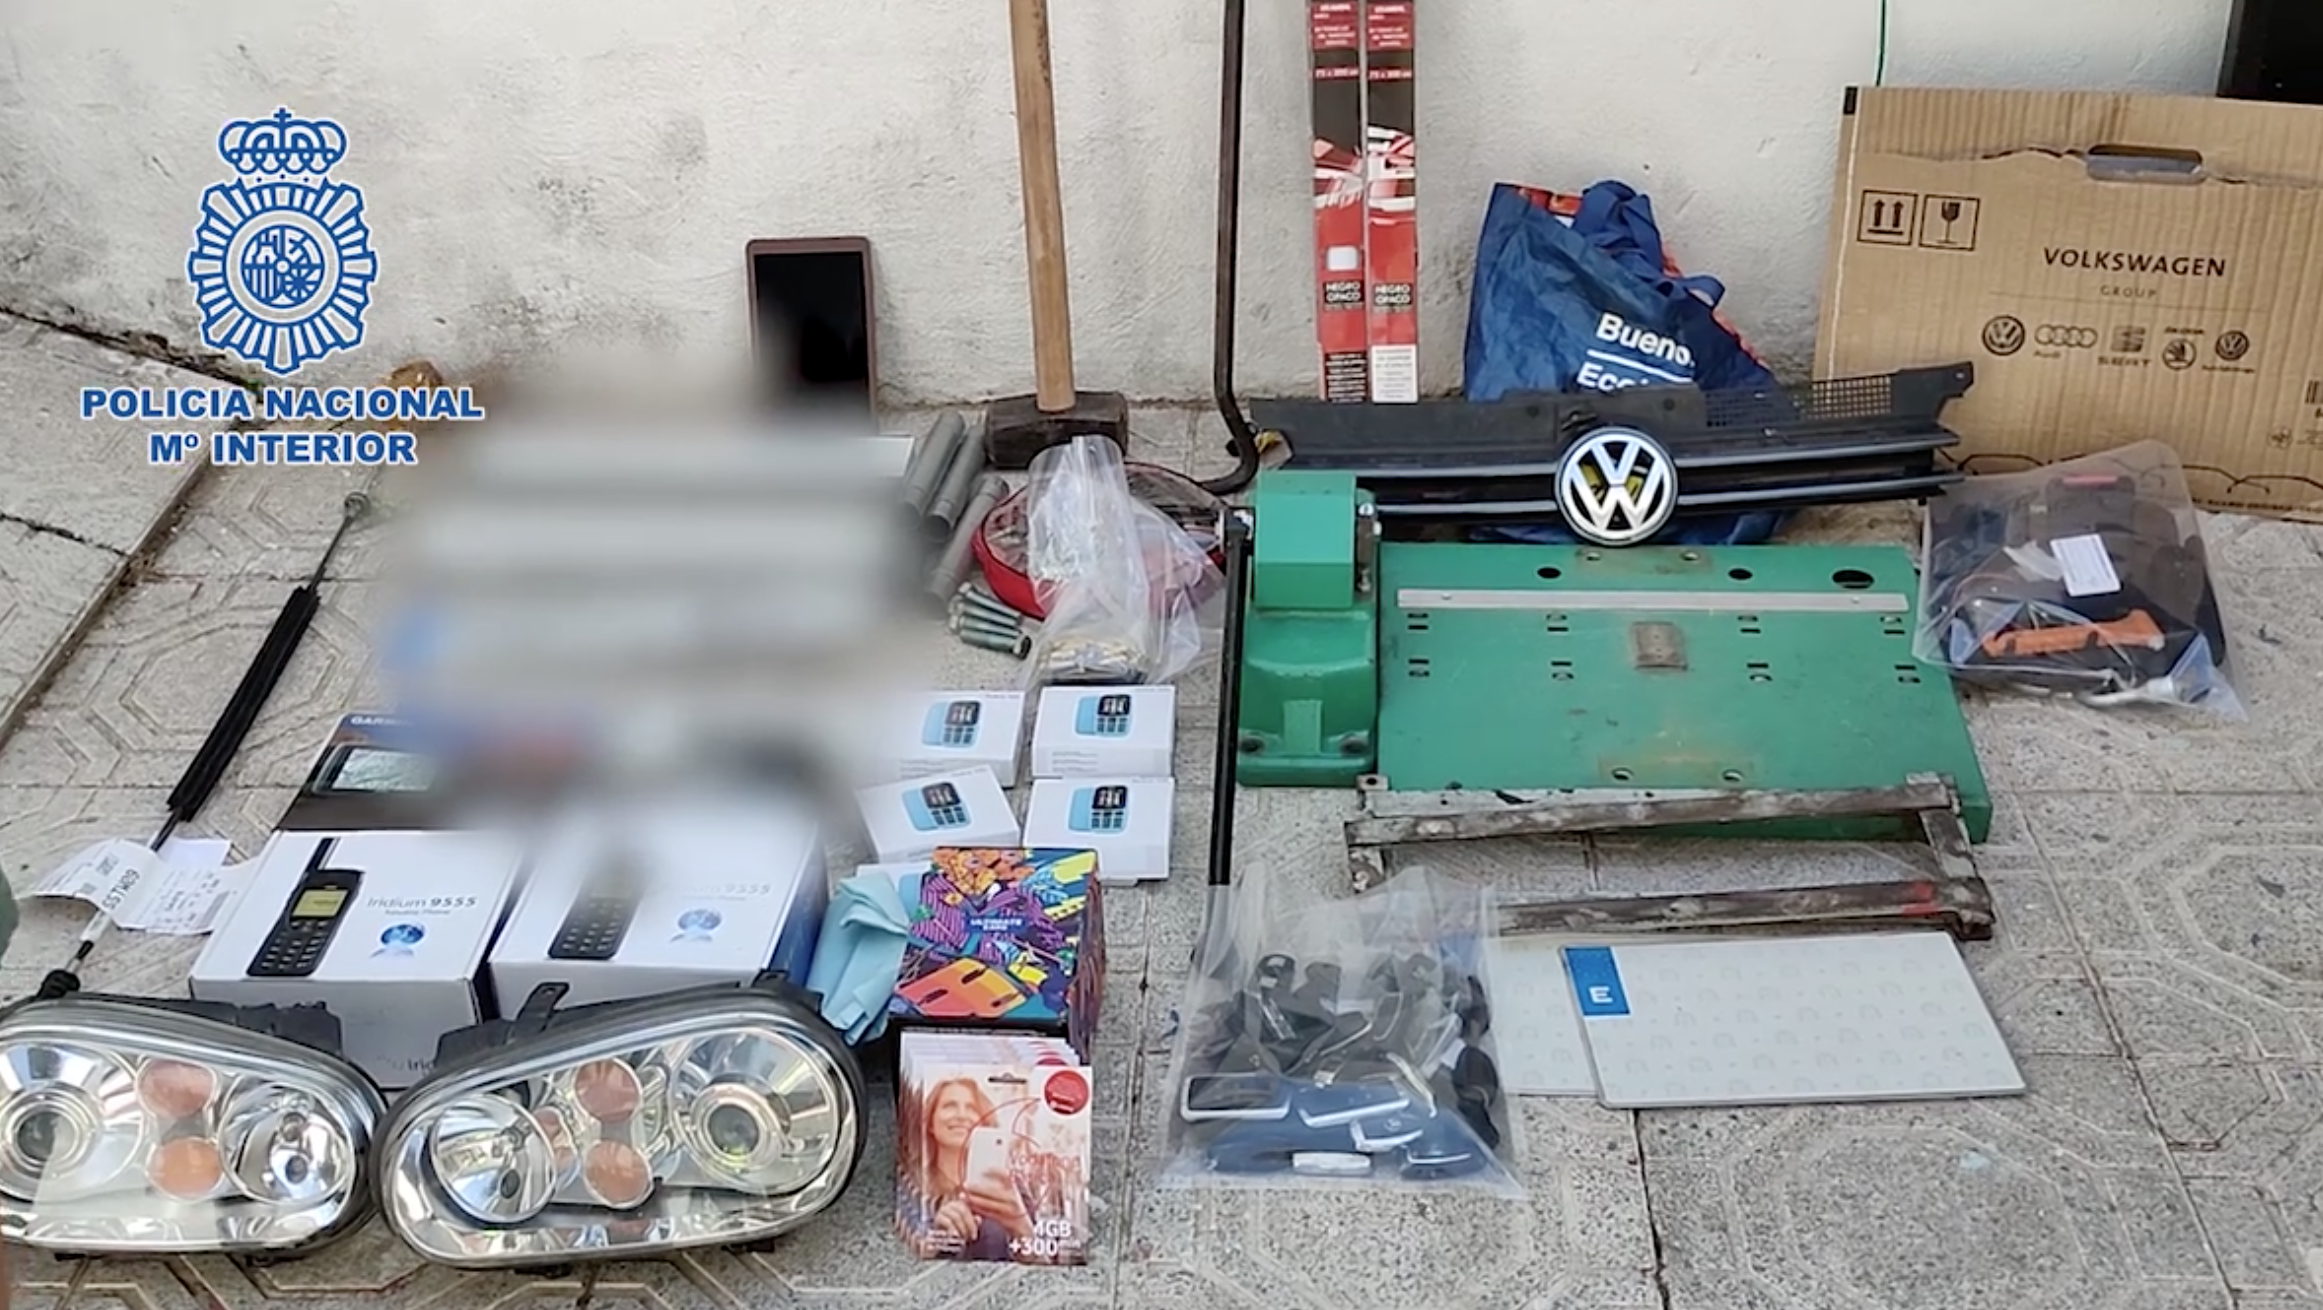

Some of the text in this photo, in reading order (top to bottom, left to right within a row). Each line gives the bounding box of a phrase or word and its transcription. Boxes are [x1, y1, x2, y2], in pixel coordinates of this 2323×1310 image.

[2043, 247, 2226, 278] VOLKSWAGEN
[1326, 281, 1361, 292] NEGRO
[1375, 283, 1411, 294] NEGRO
[2100, 284, 2158, 299] GROUP
[1326, 292, 1361, 303] OPACO
[1375, 294, 1411, 305] OPACO
[366, 896, 478, 909] Iridium 9555
[1588, 984, 1614, 1005] E
[1033, 1219, 1072, 1238] 4GB
